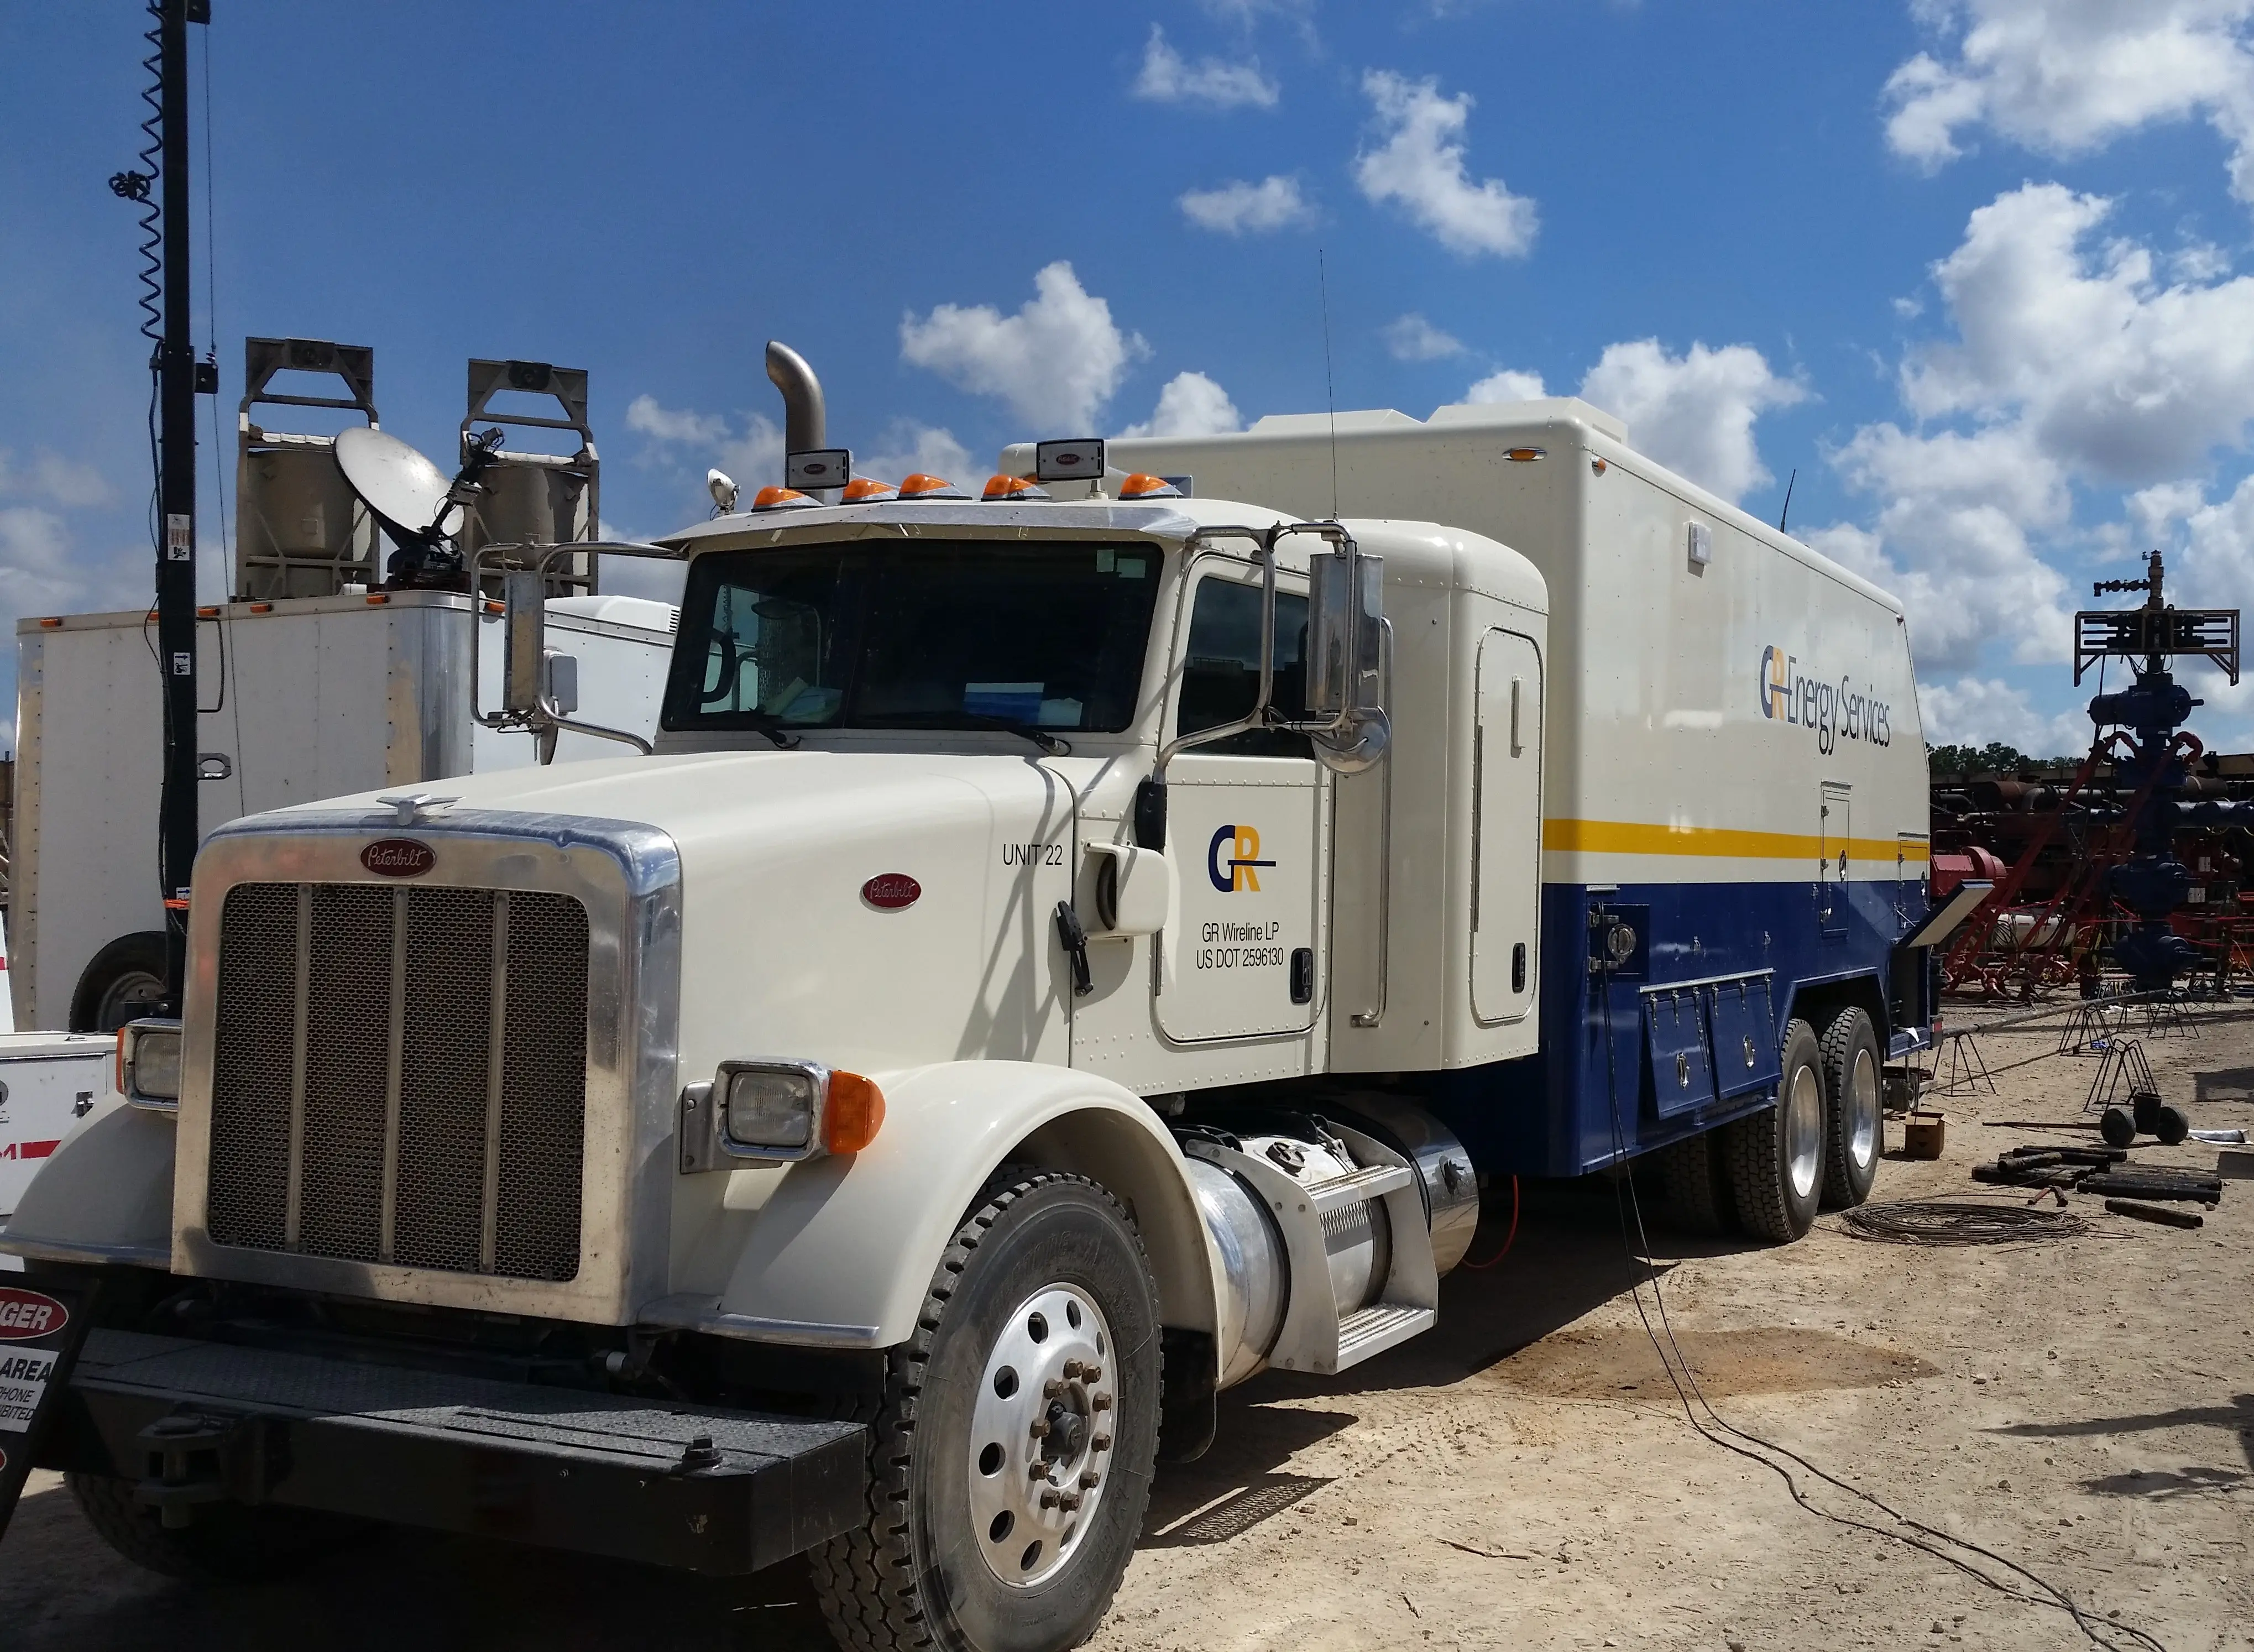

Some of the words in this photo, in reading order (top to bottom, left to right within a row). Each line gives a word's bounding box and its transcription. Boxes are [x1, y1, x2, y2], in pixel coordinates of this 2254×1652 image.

[1787, 656, 1839, 756] Energy
[1841, 675, 1890, 747] Services
[368, 845, 427, 867] Peterbilt
[1003, 844, 1041, 865] UNIT
[1045, 844, 1063, 865] 22
[1208, 824, 1276, 892] GR
[870, 879, 916, 900] Peterbilt
[1202, 922, 1220, 943] GR
[1222, 922, 1263, 942] Wireline
[1265, 922, 1279, 940] LP
[1196, 949, 1213, 969] US
[1216, 948, 1241, 968] DOT
[1242, 947, 1284, 967] 2596130
[0, 1357, 52, 1382] AREA
